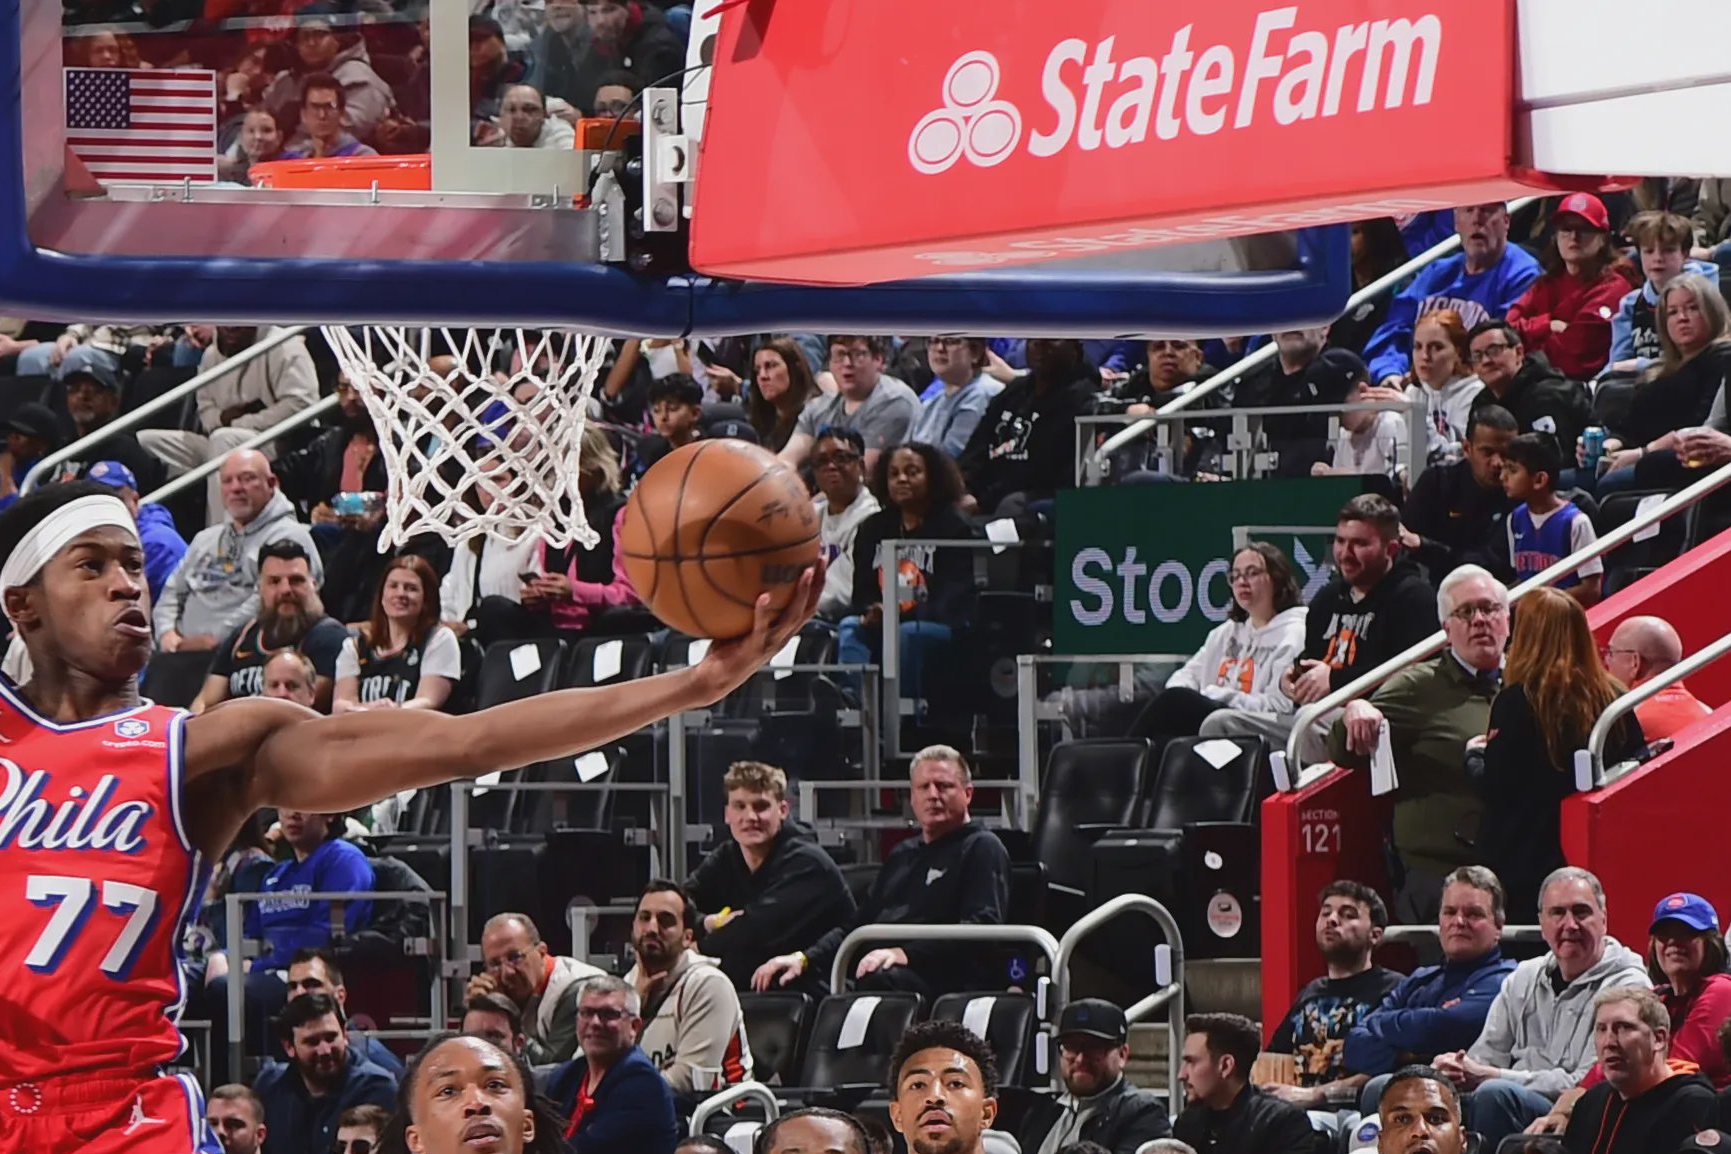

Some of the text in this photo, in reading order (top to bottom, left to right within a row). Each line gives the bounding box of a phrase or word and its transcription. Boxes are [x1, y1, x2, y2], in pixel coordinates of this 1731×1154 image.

[1027, 8, 1442, 158] StateFarm
[229, 664, 265, 697] DETR
[1301, 823, 1341, 854] 121
[24, 874, 160, 982] 77
